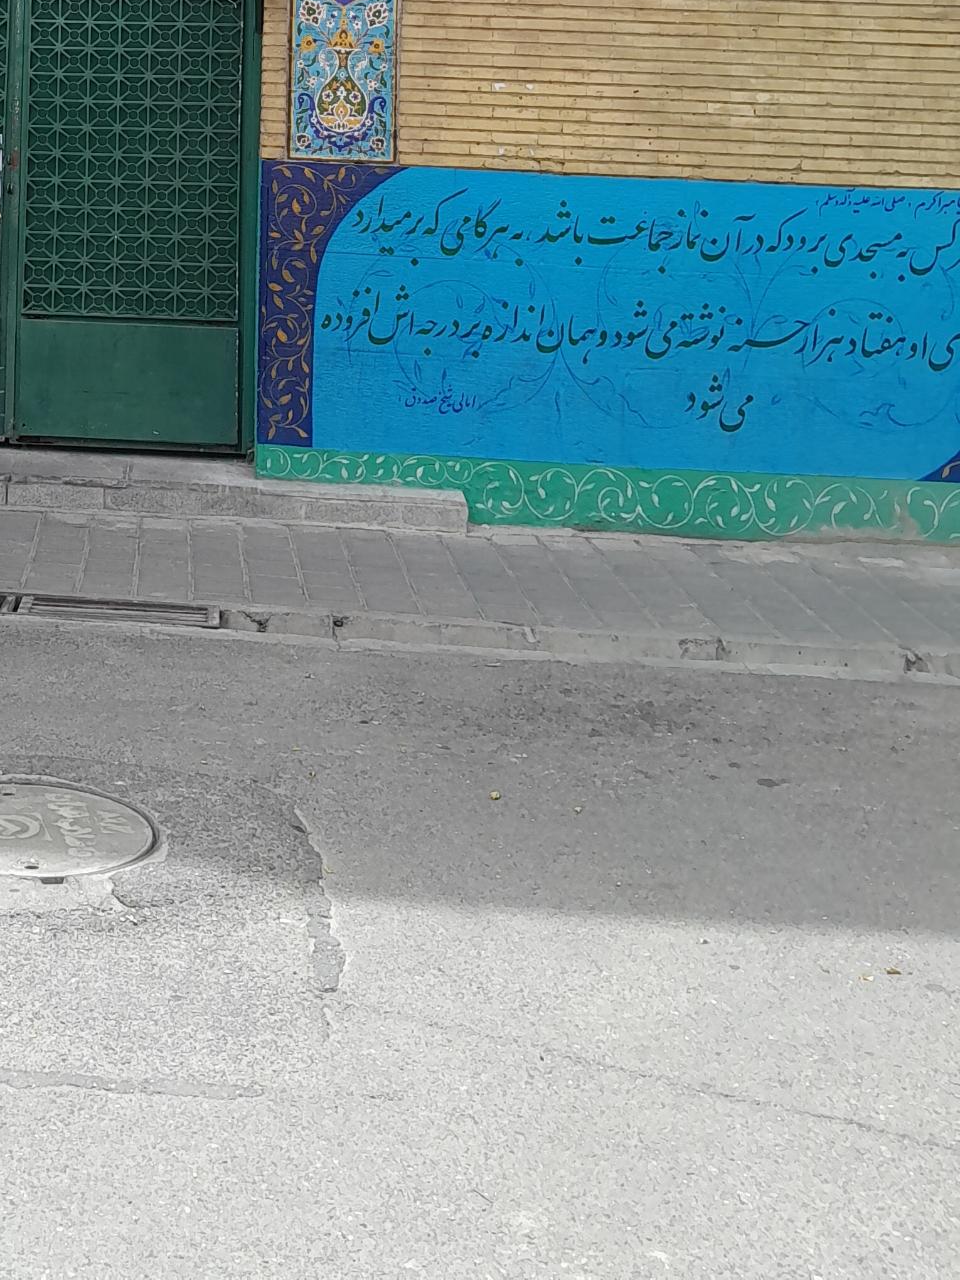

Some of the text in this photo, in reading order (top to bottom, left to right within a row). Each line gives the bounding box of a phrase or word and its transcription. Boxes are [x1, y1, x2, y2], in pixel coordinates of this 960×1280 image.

[422, 187, 469, 235] که
[440, 198, 502, 256] گامی
[667, 209, 710, 252] نماز
[765, 208, 809, 253] که
[472, 224, 510, 260] هر
[587, 215, 674, 275] جماعت
[700, 214, 757, 262] آن
[742, 234, 764, 256] در
[783, 233, 829, 275] برود
[823, 233, 904, 280] مسجدی
[895, 248, 912, 282] به
[320, 286, 381, 342] افزوده
[415, 319, 460, 356] درجه
[482, 302, 546, 343] اندازه
[611, 300, 649, 349] شود
[675, 303, 727, 350] نوشته
[793, 308, 845, 367] هزار
[845, 311, 906, 359] هفتاد
[460, 320, 482, 358] بر
[535, 314, 597, 365] همان
[595, 330, 608, 348] و
[906, 332, 928, 361] او
[684, 374, 754, 433] می شود
